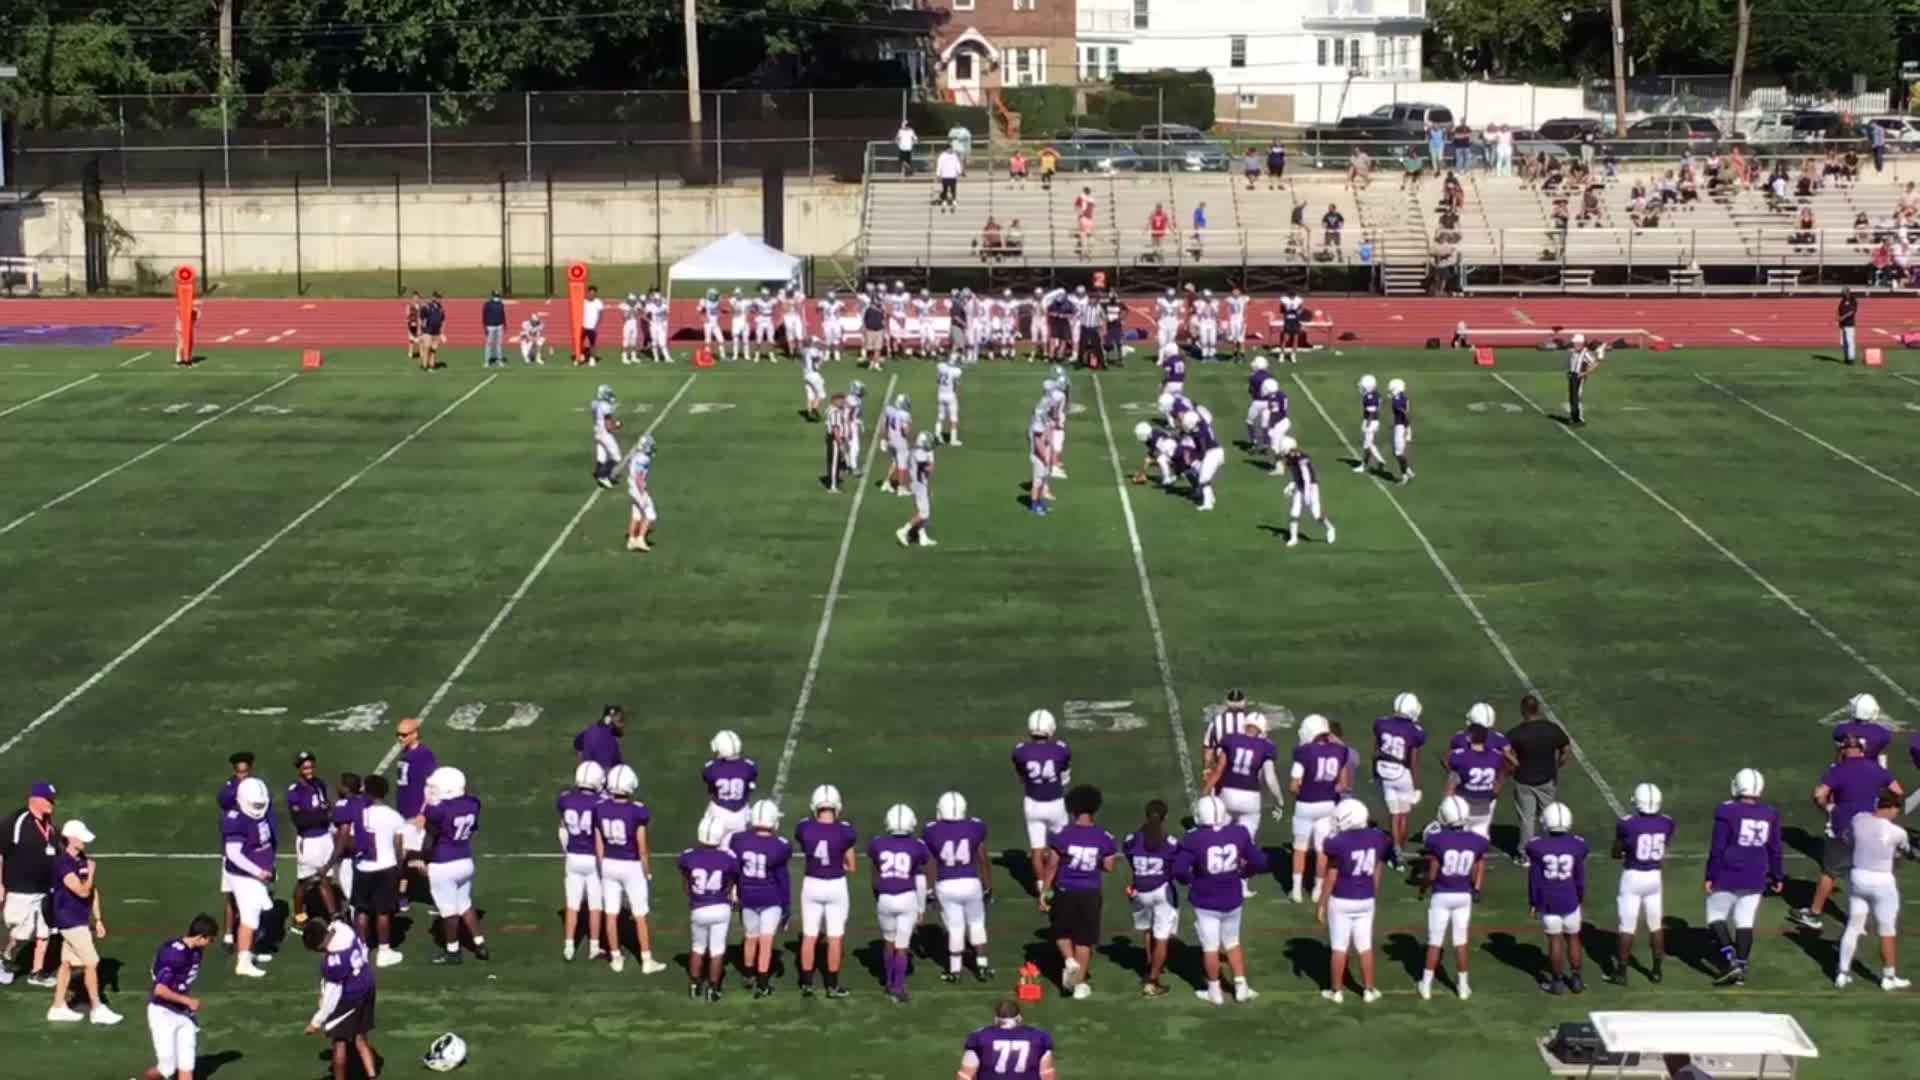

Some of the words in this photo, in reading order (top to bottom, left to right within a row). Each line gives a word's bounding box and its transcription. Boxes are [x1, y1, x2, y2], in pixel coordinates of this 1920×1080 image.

[1026, 759, 1058, 784] 24
[1231, 748, 1254, 774] 11
[1469, 767, 1496, 785] 22
[564, 809, 592, 836] 94
[1738, 818, 1769, 847] 53
[813, 839, 830, 866] 4
[940, 838, 971, 867] 44
[1068, 845, 1099, 871] 75
[1206, 844, 1239, 875] 62
[1636, 833, 1666, 861] 85
[742, 850, 767, 879] 31
[1351, 848, 1376, 877] 74
[1441, 849, 1475, 877] 80
[1542, 854, 1574, 880] 33
[691, 867, 723, 895] 34
[992, 1039, 1031, 1074] 77
